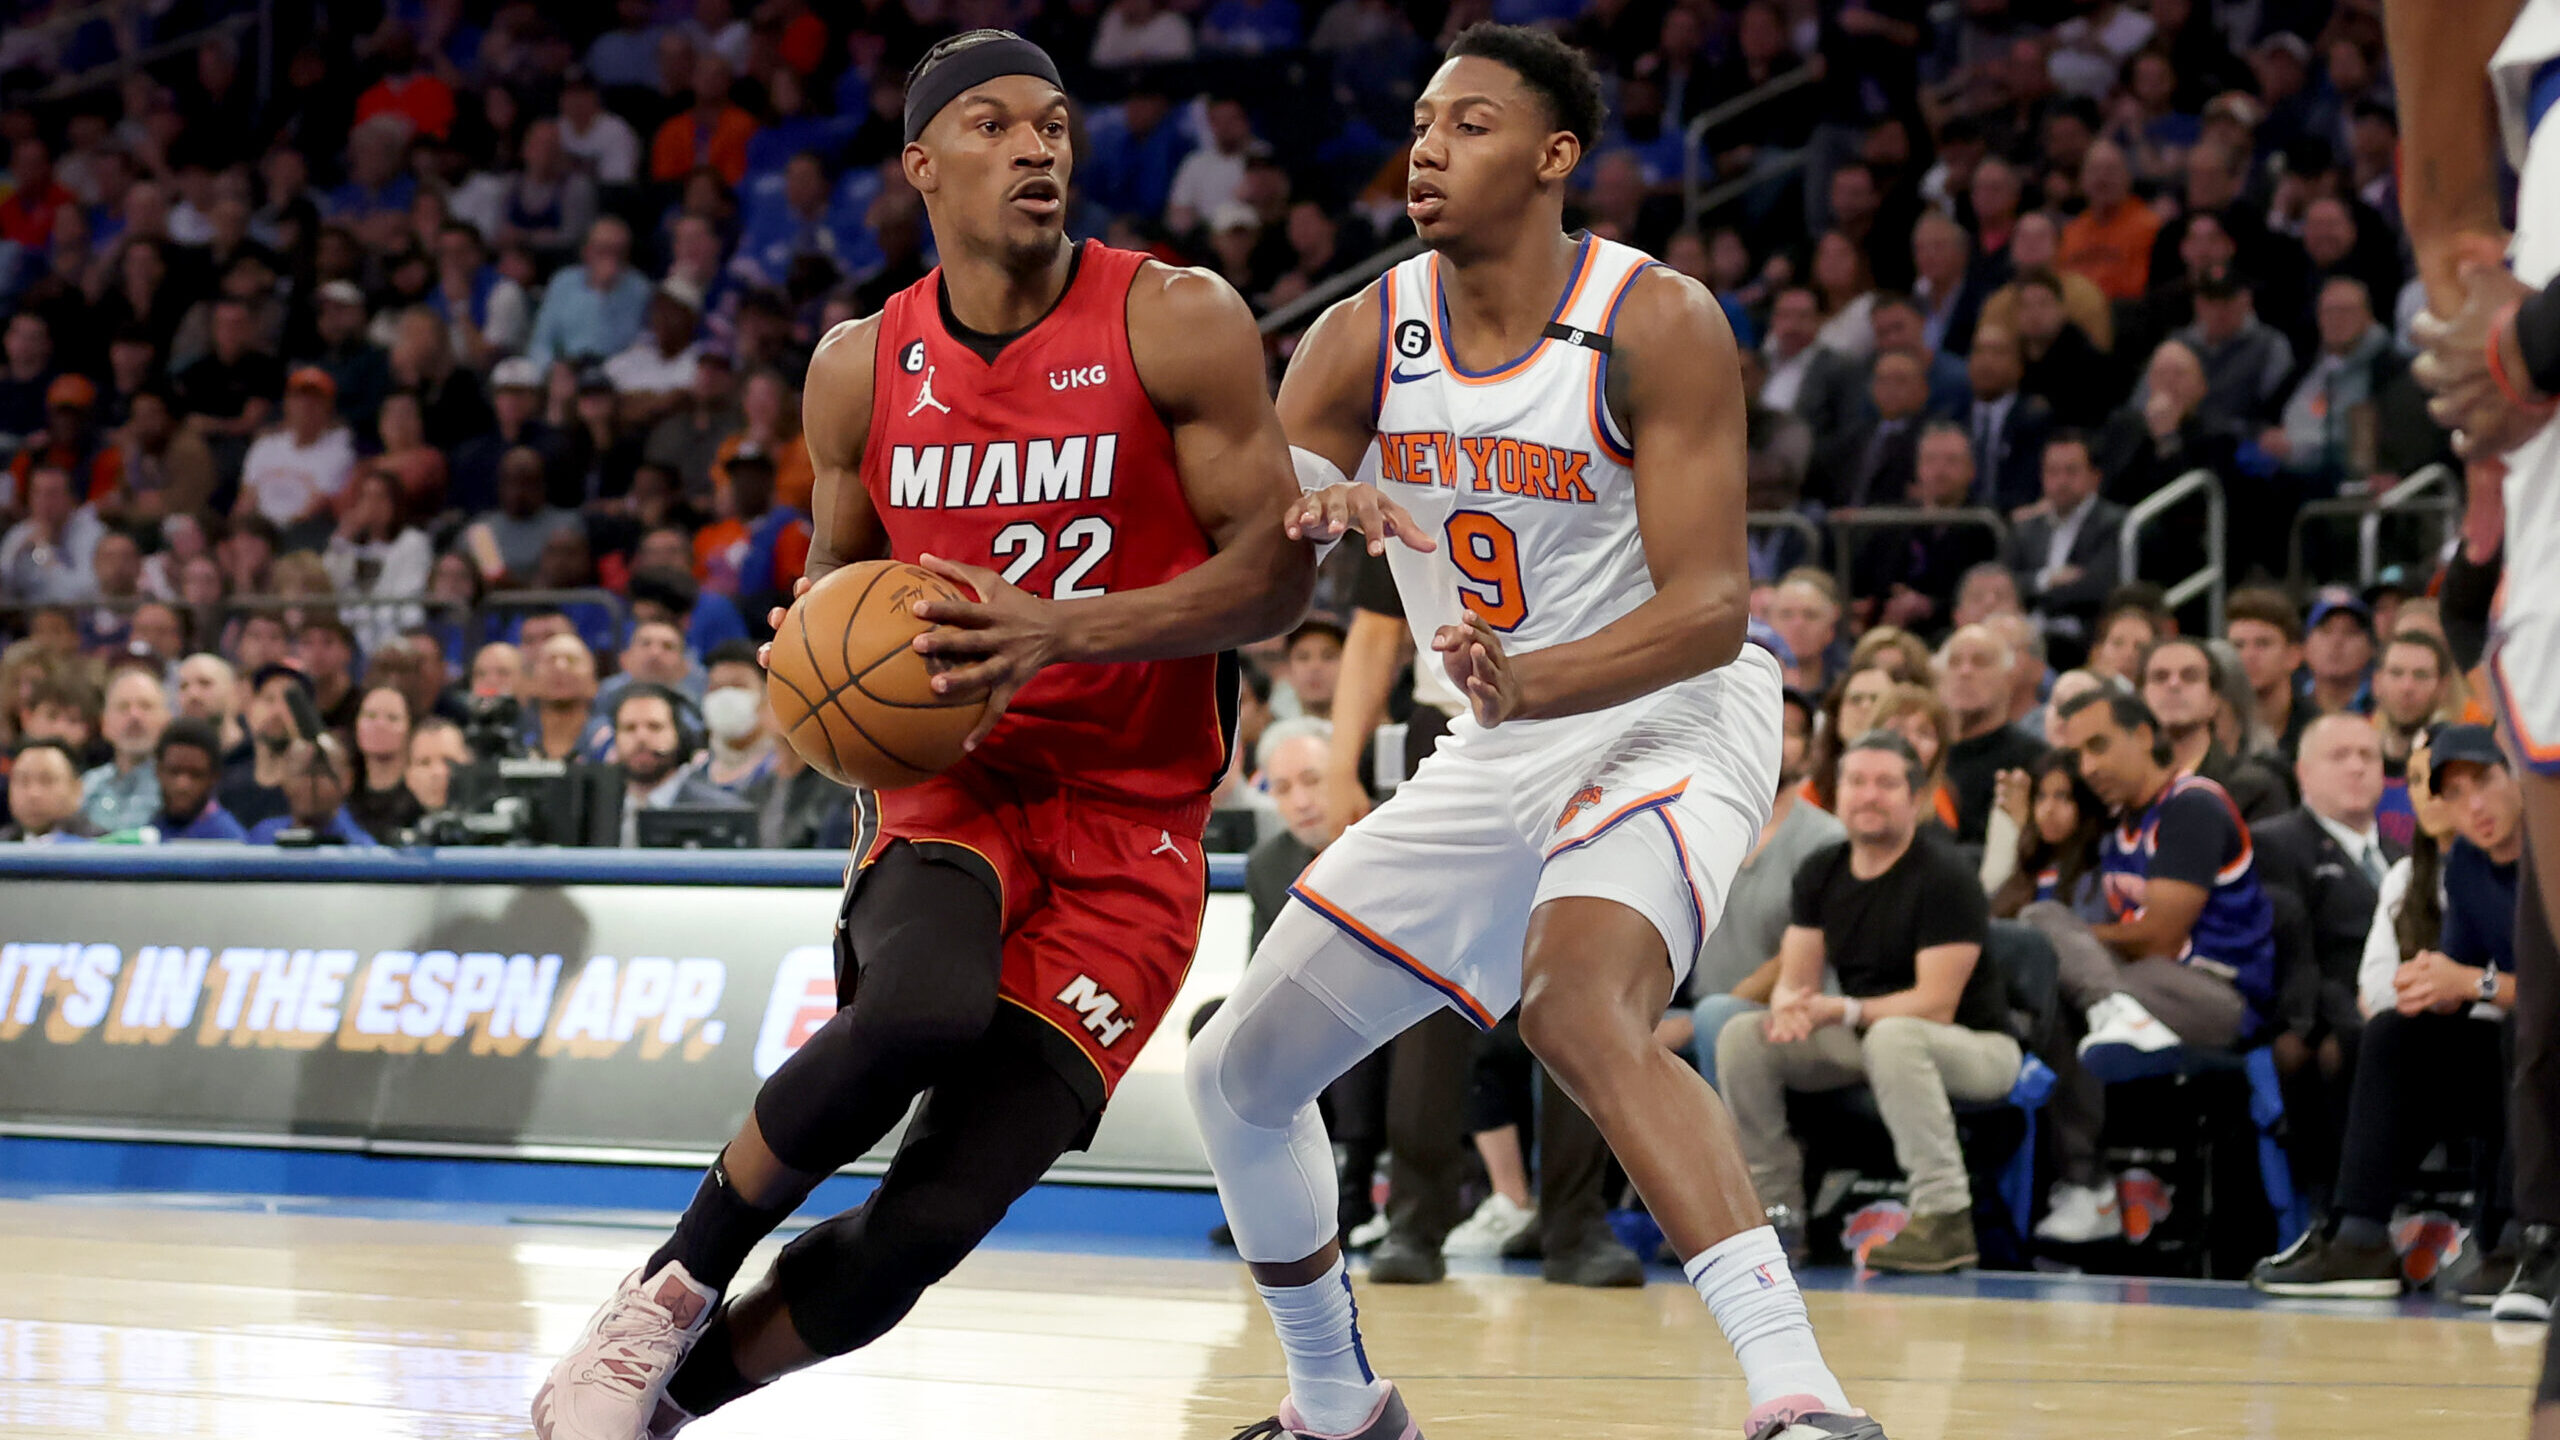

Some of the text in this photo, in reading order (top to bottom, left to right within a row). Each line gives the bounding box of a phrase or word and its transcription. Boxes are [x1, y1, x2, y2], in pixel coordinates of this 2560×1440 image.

[905, 341, 925, 372] 6
[1400, 324, 1426, 355] 6
[1567, 329, 1585, 345] 19
[889, 432, 1119, 509] MIAMI
[1460, 436, 1598, 504] YORK
[992, 515, 1115, 601] 22
[1443, 509, 1529, 633] 9
[0, 942, 726, 1045] IT'S IN THE ESPN APP.
